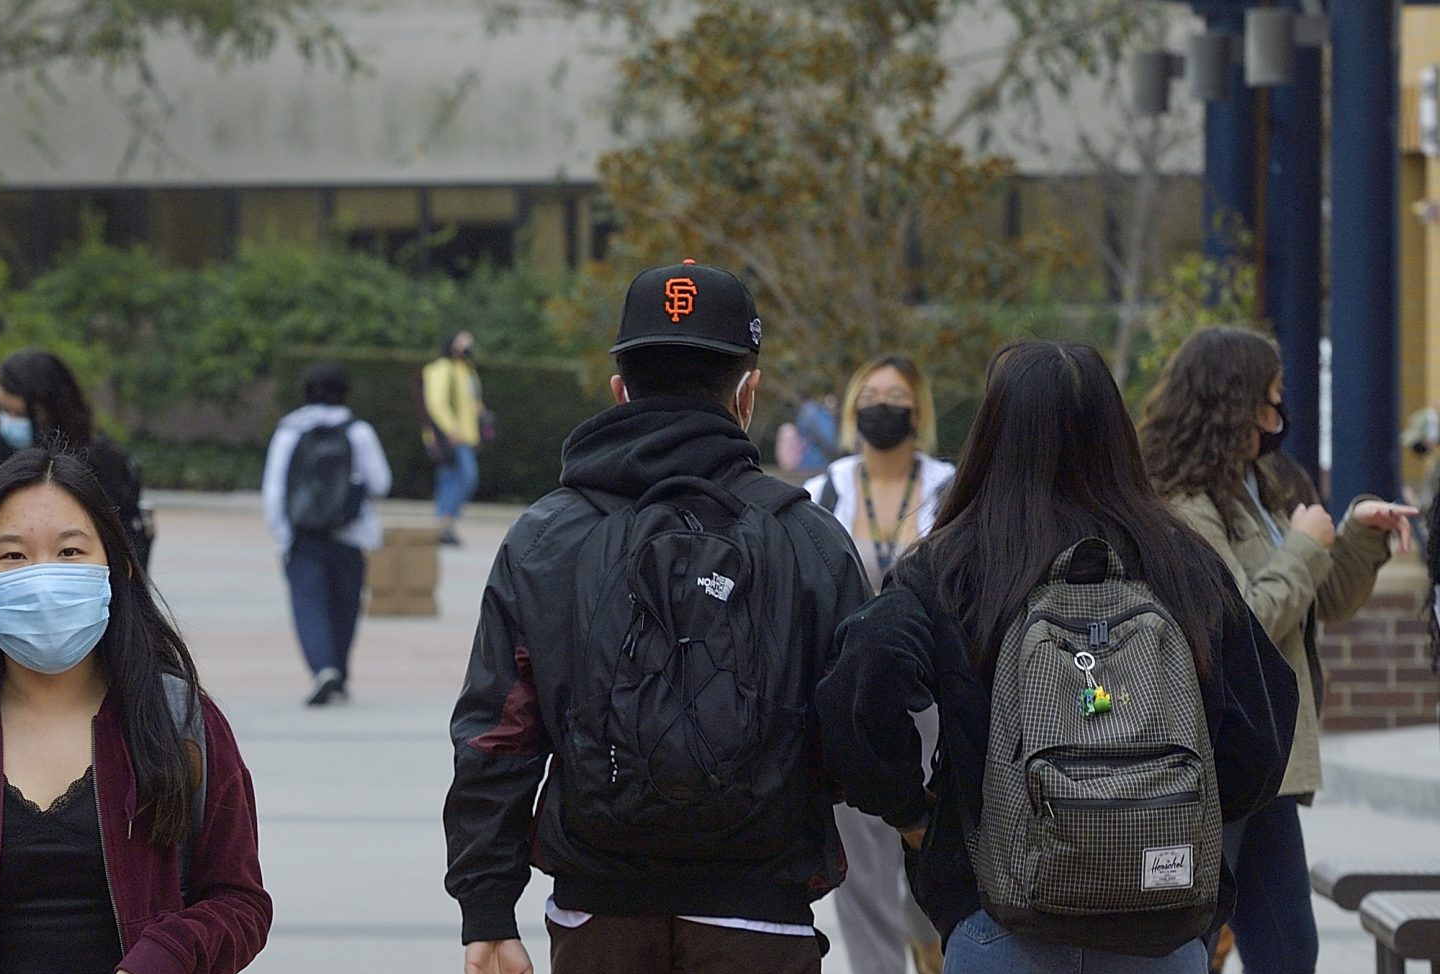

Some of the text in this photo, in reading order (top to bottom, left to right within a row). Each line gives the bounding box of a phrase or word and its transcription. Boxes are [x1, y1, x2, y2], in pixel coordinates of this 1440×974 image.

[664, 277, 698, 323] SF
[697, 577, 725, 592] NORTH
[712, 571, 726, 585] THE
[705, 586, 725, 599] FACE
[1151, 854, 1185, 874] Herschel
